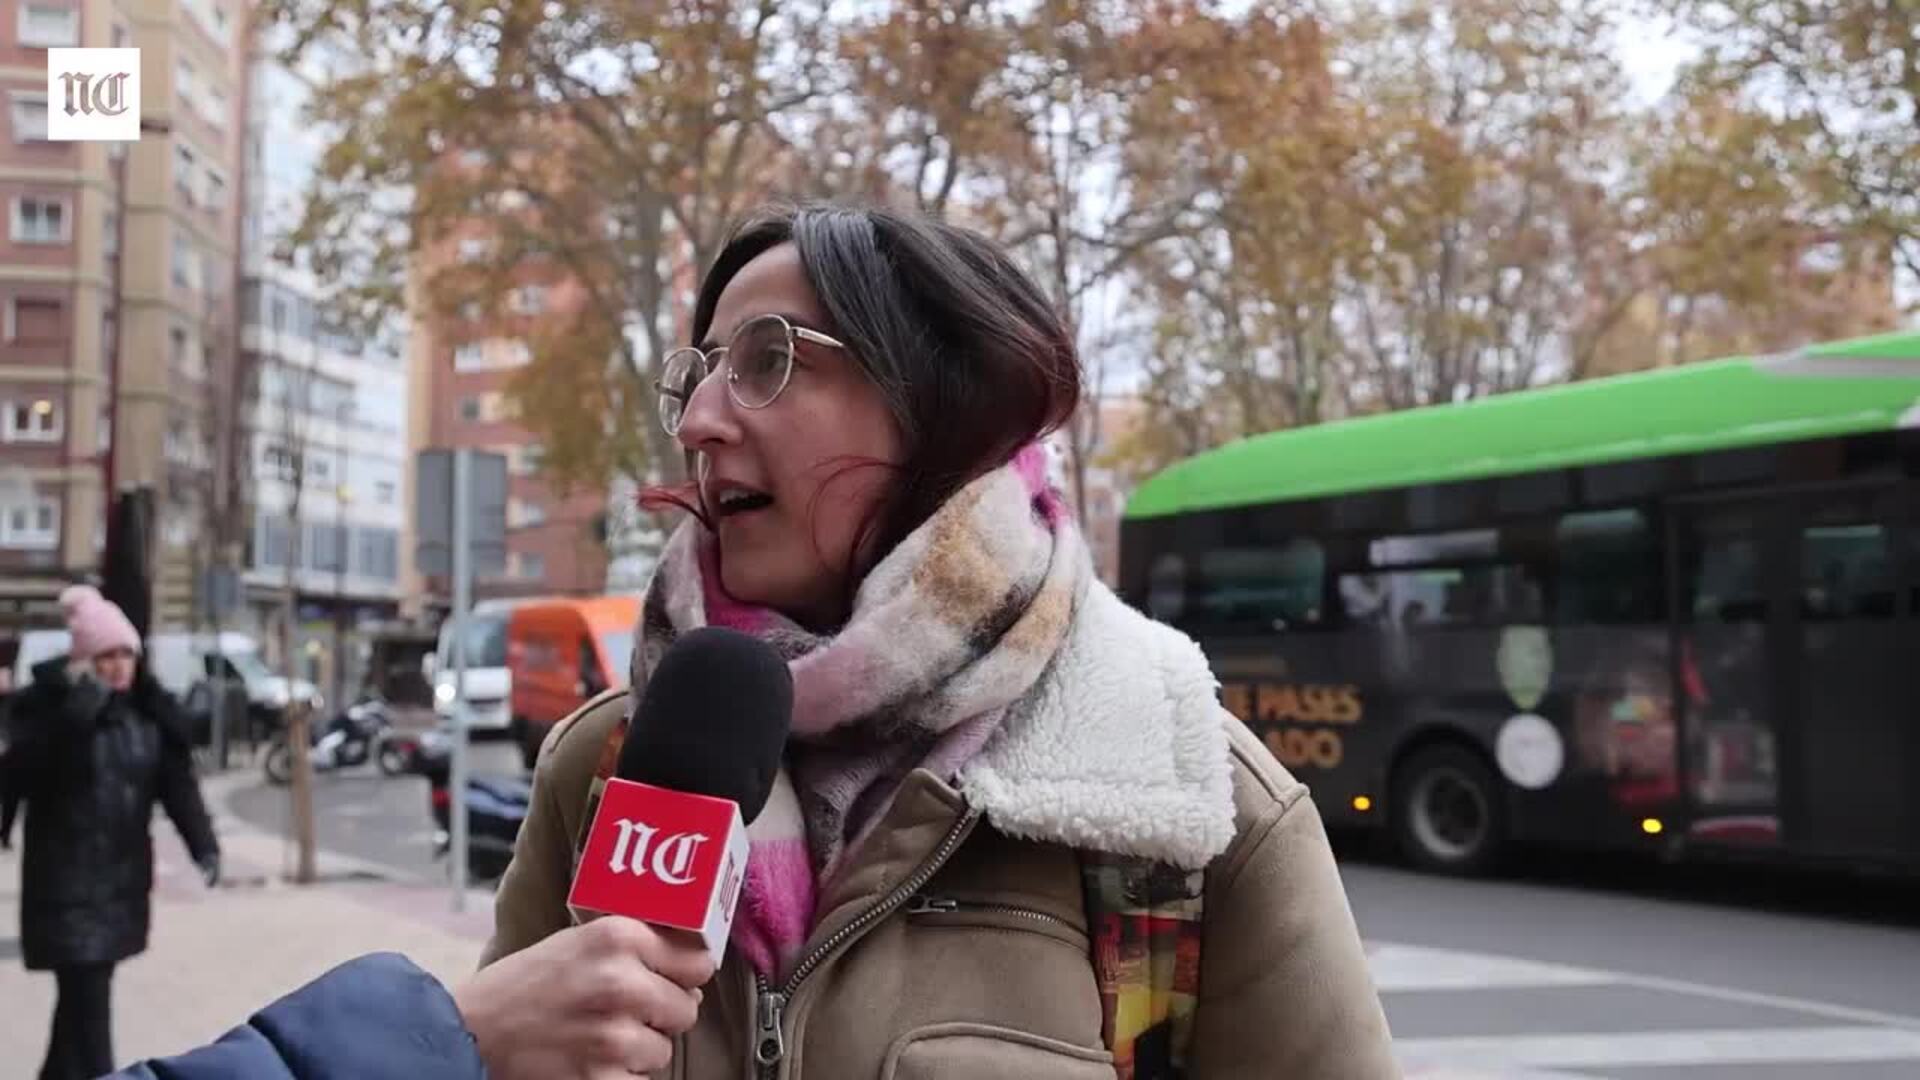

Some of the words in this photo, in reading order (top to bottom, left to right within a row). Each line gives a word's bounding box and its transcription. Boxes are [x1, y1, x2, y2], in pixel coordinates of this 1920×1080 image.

[1257, 682, 1363, 722] PASES
[1264, 728, 1343, 768] ADO
[610, 818, 709, 884] NC
